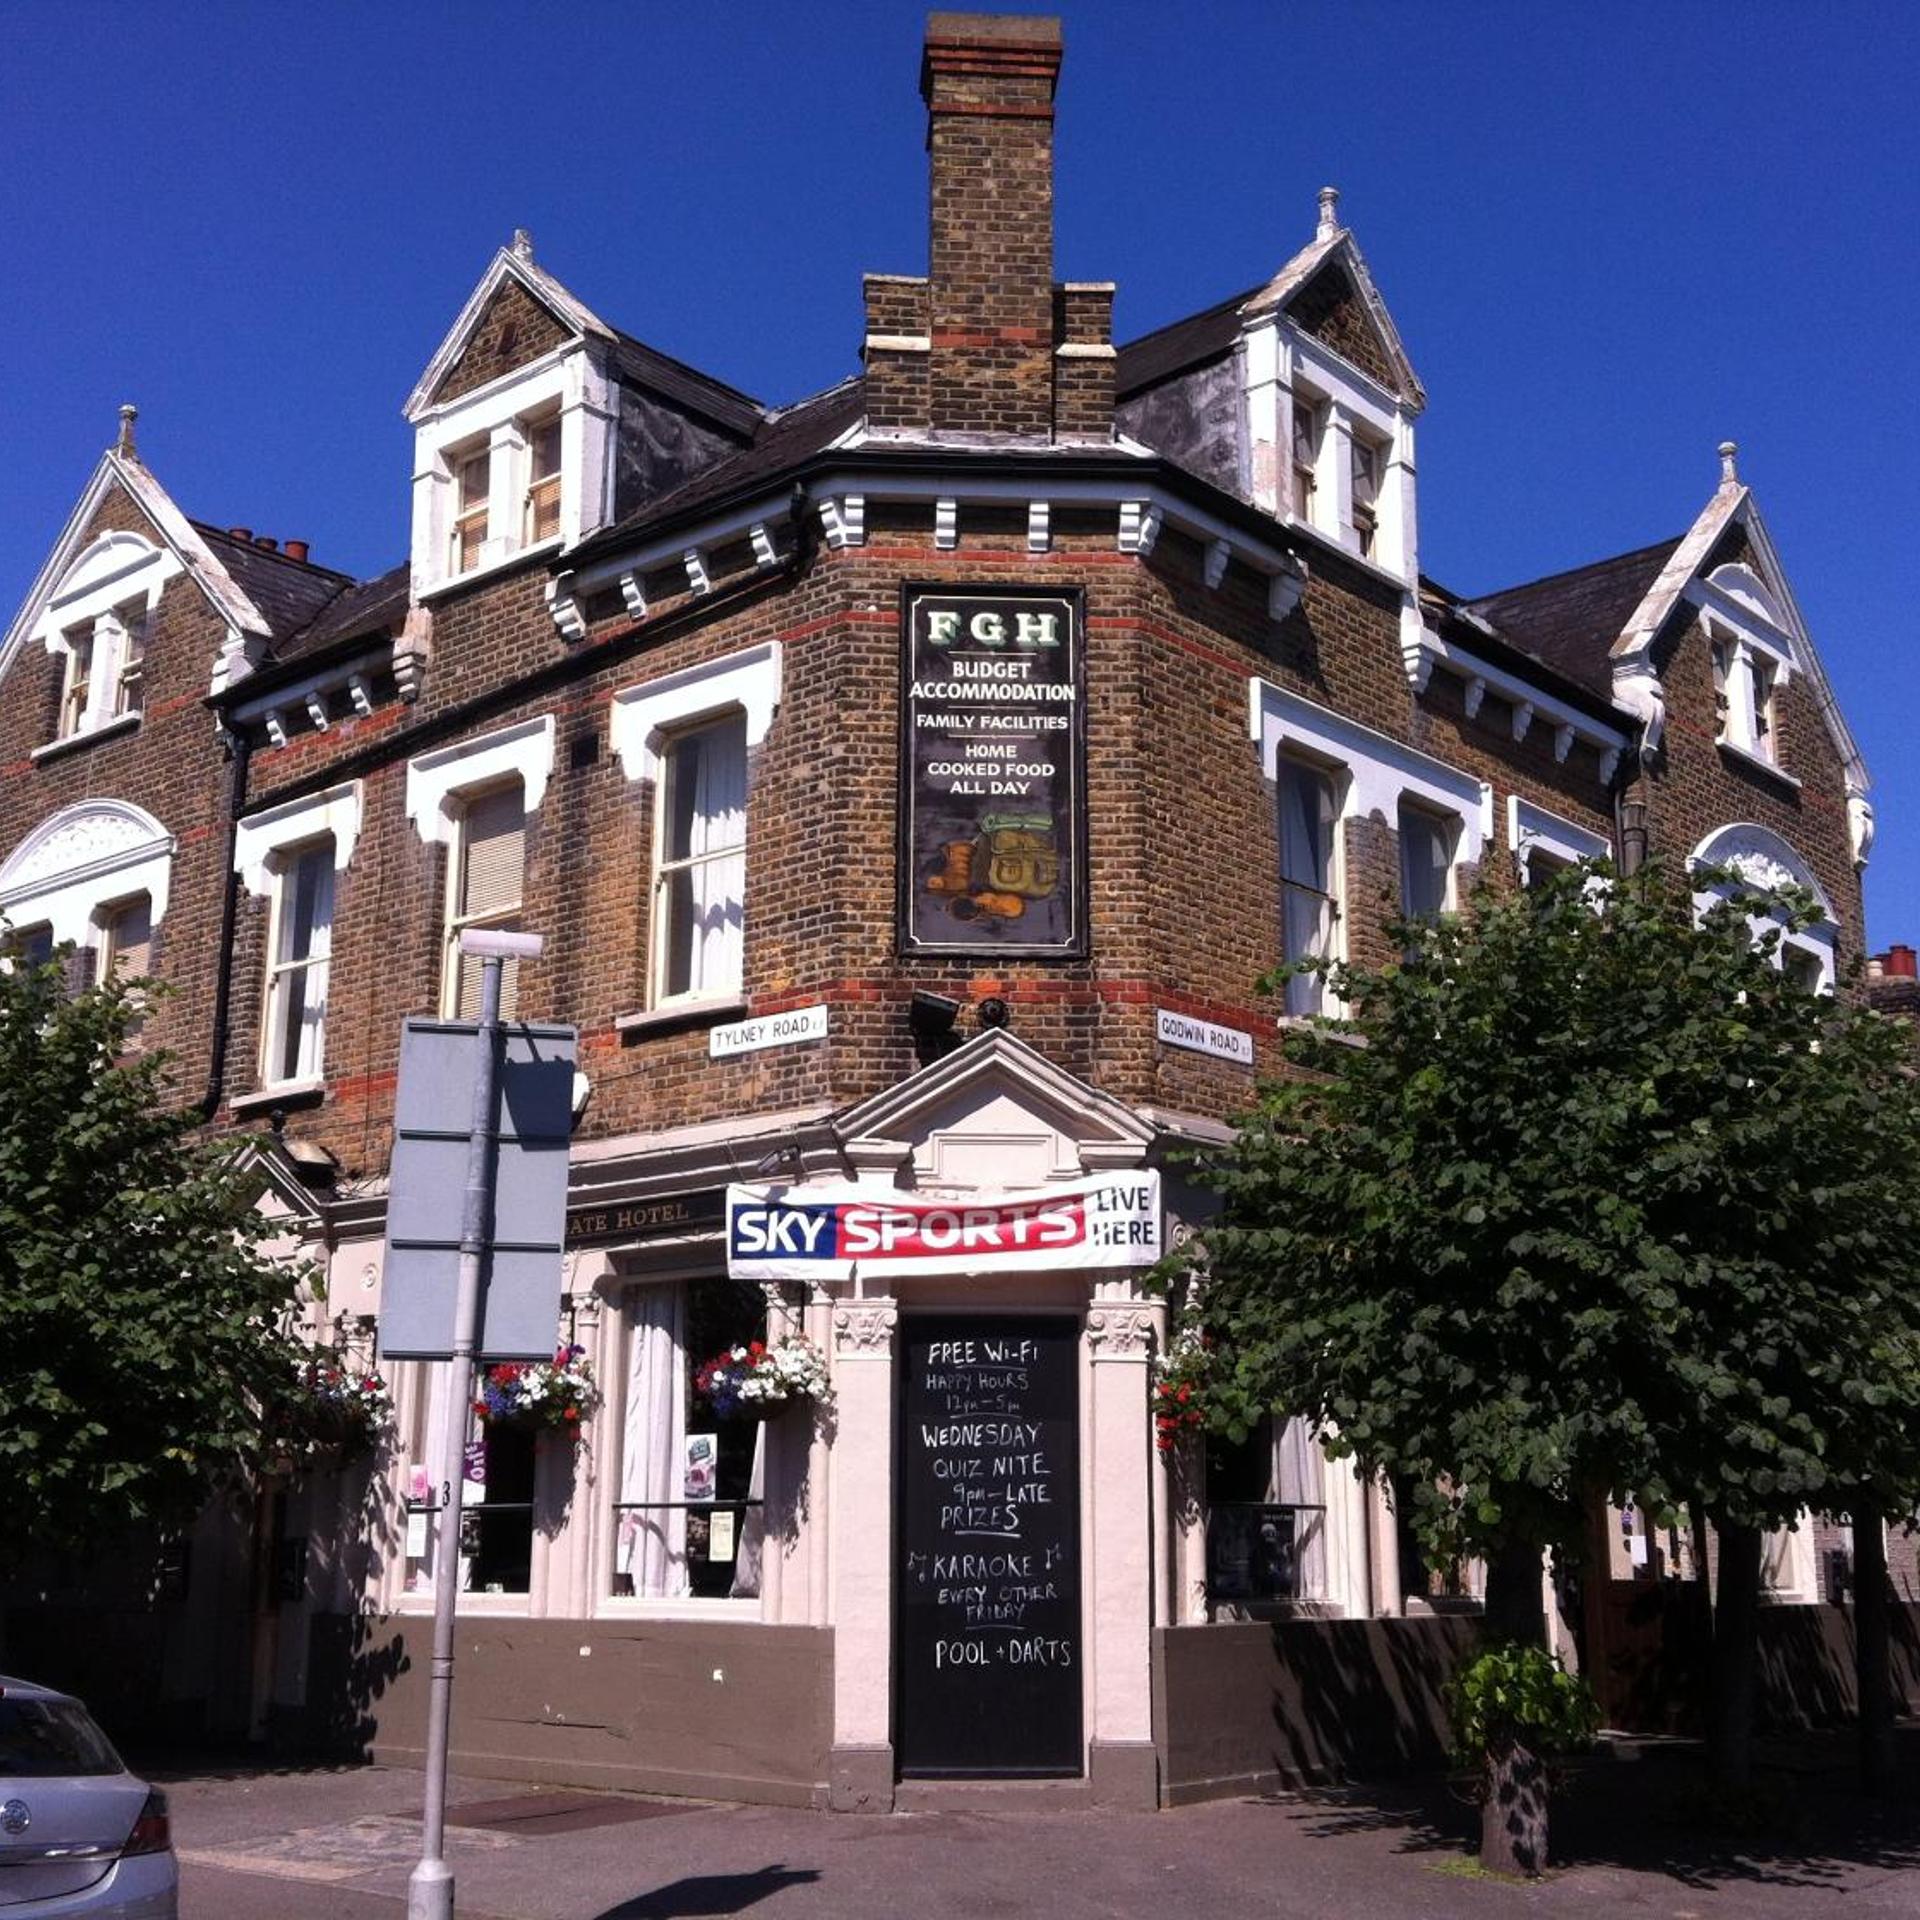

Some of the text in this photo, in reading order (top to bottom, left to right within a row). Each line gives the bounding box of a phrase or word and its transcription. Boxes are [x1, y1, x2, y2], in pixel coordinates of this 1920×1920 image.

[928, 611, 1060, 646] FGH
[952, 661, 1031, 678] BUDGET
[909, 682, 1076, 700] ACCOMMODATION
[916, 714, 1068, 729] FAMILY FACILITIES
[965, 744, 1017, 758] HOME
[928, 762, 1055, 777] COOKED FOOD
[950, 781, 1031, 795] ALL DAY
[715, 1025, 766, 1047] TYLNEY
[773, 1016, 809, 1037] ROAD
[1162, 1018, 1205, 1044] GODWIN
[1210, 1030, 1239, 1053] ROAD
[1096, 1187, 1150, 1212] LIVE
[566, 1203, 689, 1235] ATE HOTEL
[736, 1200, 1077, 1253] SKY SPORTS
[1093, 1220, 1155, 1246] HERE
[928, 1341, 976, 1365] FREE
[926, 1373, 1029, 1392] HAPPY HOURS
[921, 1424, 1041, 1447] WEDNESDAY
[933, 1452, 1051, 1479] QUIZ NITE
[941, 1504, 1019, 1530] PRIZES
[933, 1553, 1033, 1579] KARAOKE
[938, 1583, 1058, 1604] EVERY OTHER
[966, 1603, 1025, 1622] FRIDAY
[936, 1640, 990, 1669] POOL
[1009, 1637, 1072, 1666] DARTS
